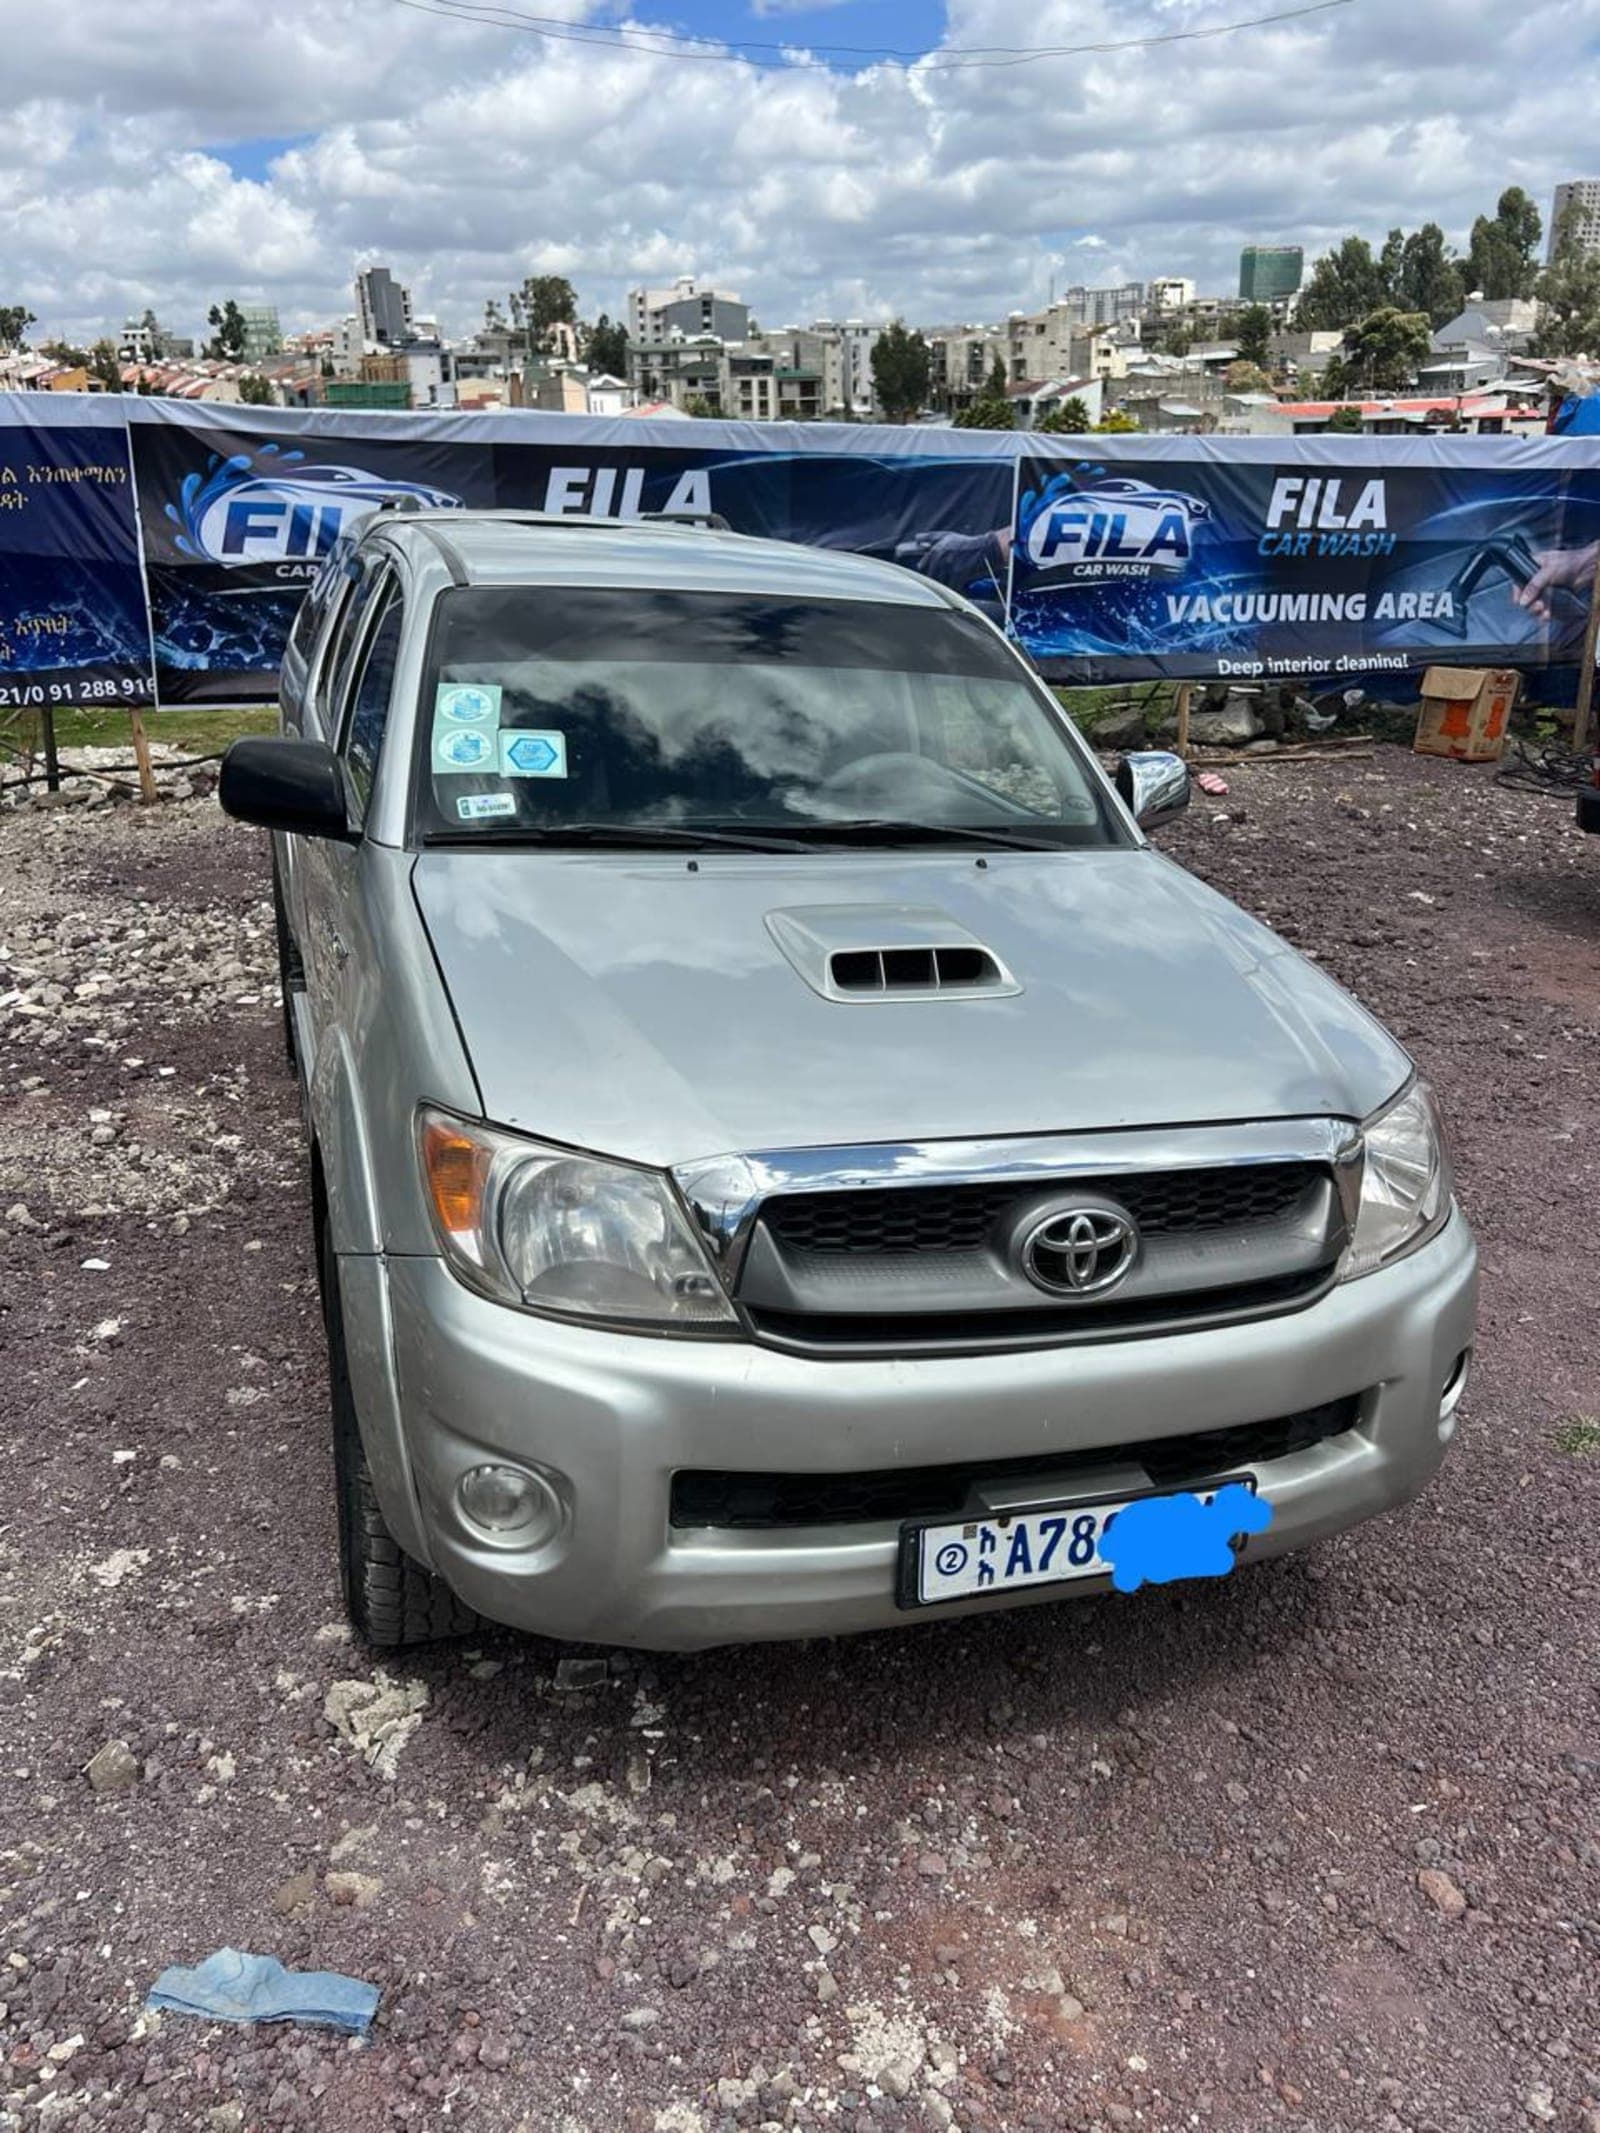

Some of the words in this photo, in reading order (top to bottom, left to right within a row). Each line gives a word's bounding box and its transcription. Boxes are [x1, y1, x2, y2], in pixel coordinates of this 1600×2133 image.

[544, 467, 712, 522] FILA
[1266, 477, 1387, 528] FILA
[222, 501, 342, 557] FIL
[1039, 513, 1190, 558] FILA
[1258, 533, 1311, 556] CAR
[1317, 532, 1397, 557] WASH
[1073, 564, 1103, 577] CAR
[1105, 563, 1151, 577] WASH
[1166, 593, 1367, 623] VACUUMING
[1372, 591, 1455, 620] AREA
[1217, 658, 1264, 677] Deep
[1267, 656, 1332, 673] interior
[50, 682, 73, 701] 91
[80, 680, 118, 699] 288
